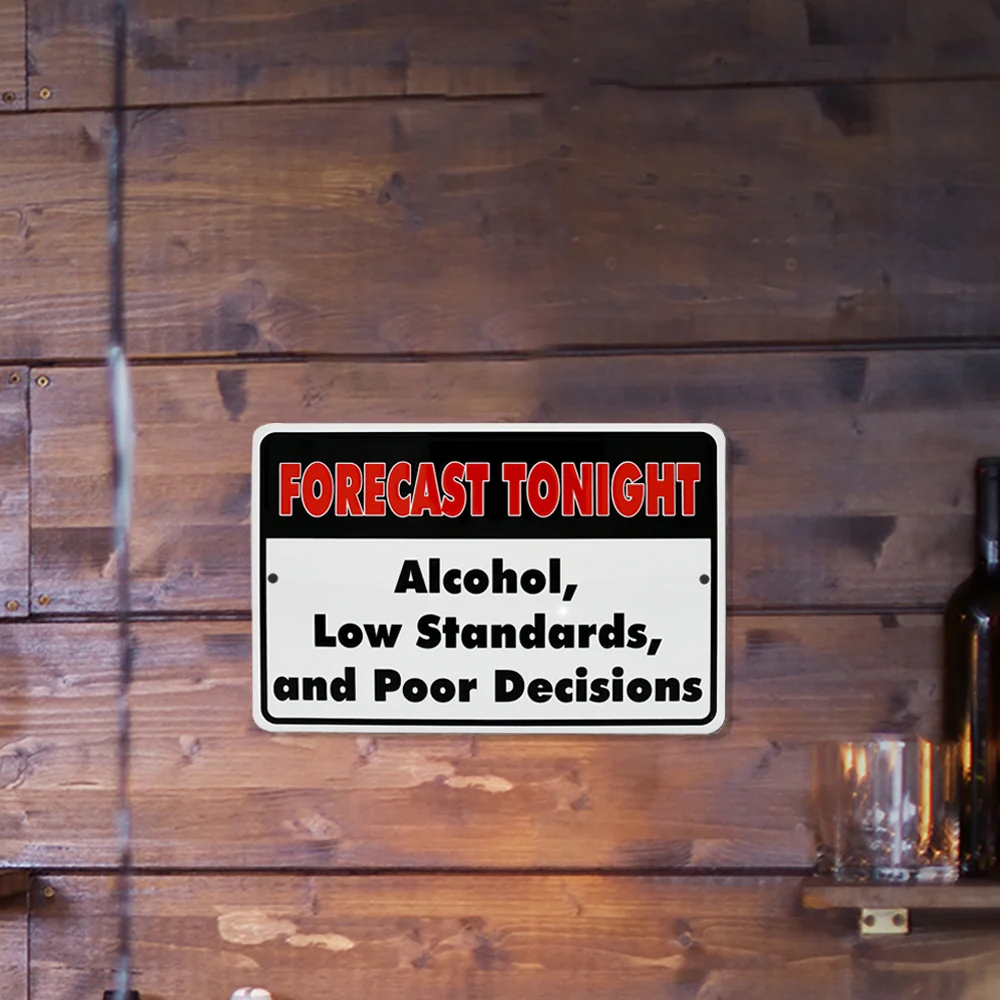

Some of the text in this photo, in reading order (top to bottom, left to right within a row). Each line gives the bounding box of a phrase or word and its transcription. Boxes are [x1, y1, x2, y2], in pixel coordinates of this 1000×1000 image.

[279, 461, 701, 517] FORECAST TONIGHT
[394, 558, 578, 601] Alcohol,
[314, 613, 662, 655] Low Standards,
[273, 666, 703, 703] and Poor Decisions
